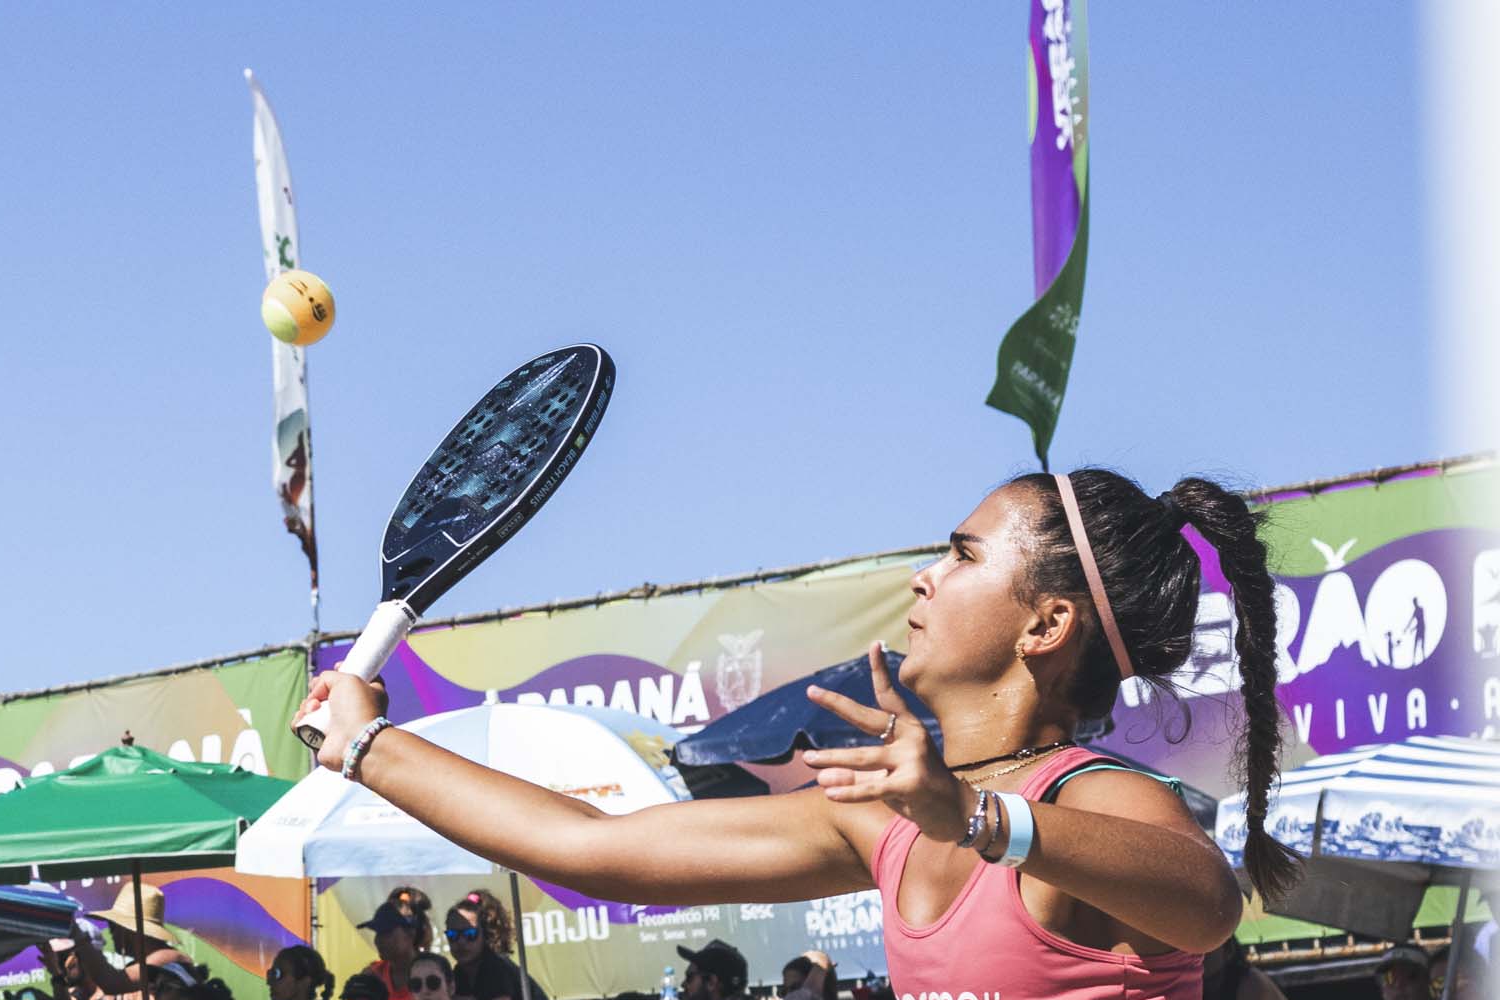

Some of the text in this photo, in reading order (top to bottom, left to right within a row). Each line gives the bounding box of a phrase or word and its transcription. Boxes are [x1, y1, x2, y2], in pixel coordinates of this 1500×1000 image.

[1293, 686, 1428, 744] VIVA
[523, 905, 610, 947] DAJU
[703, 905, 722, 922] PR
